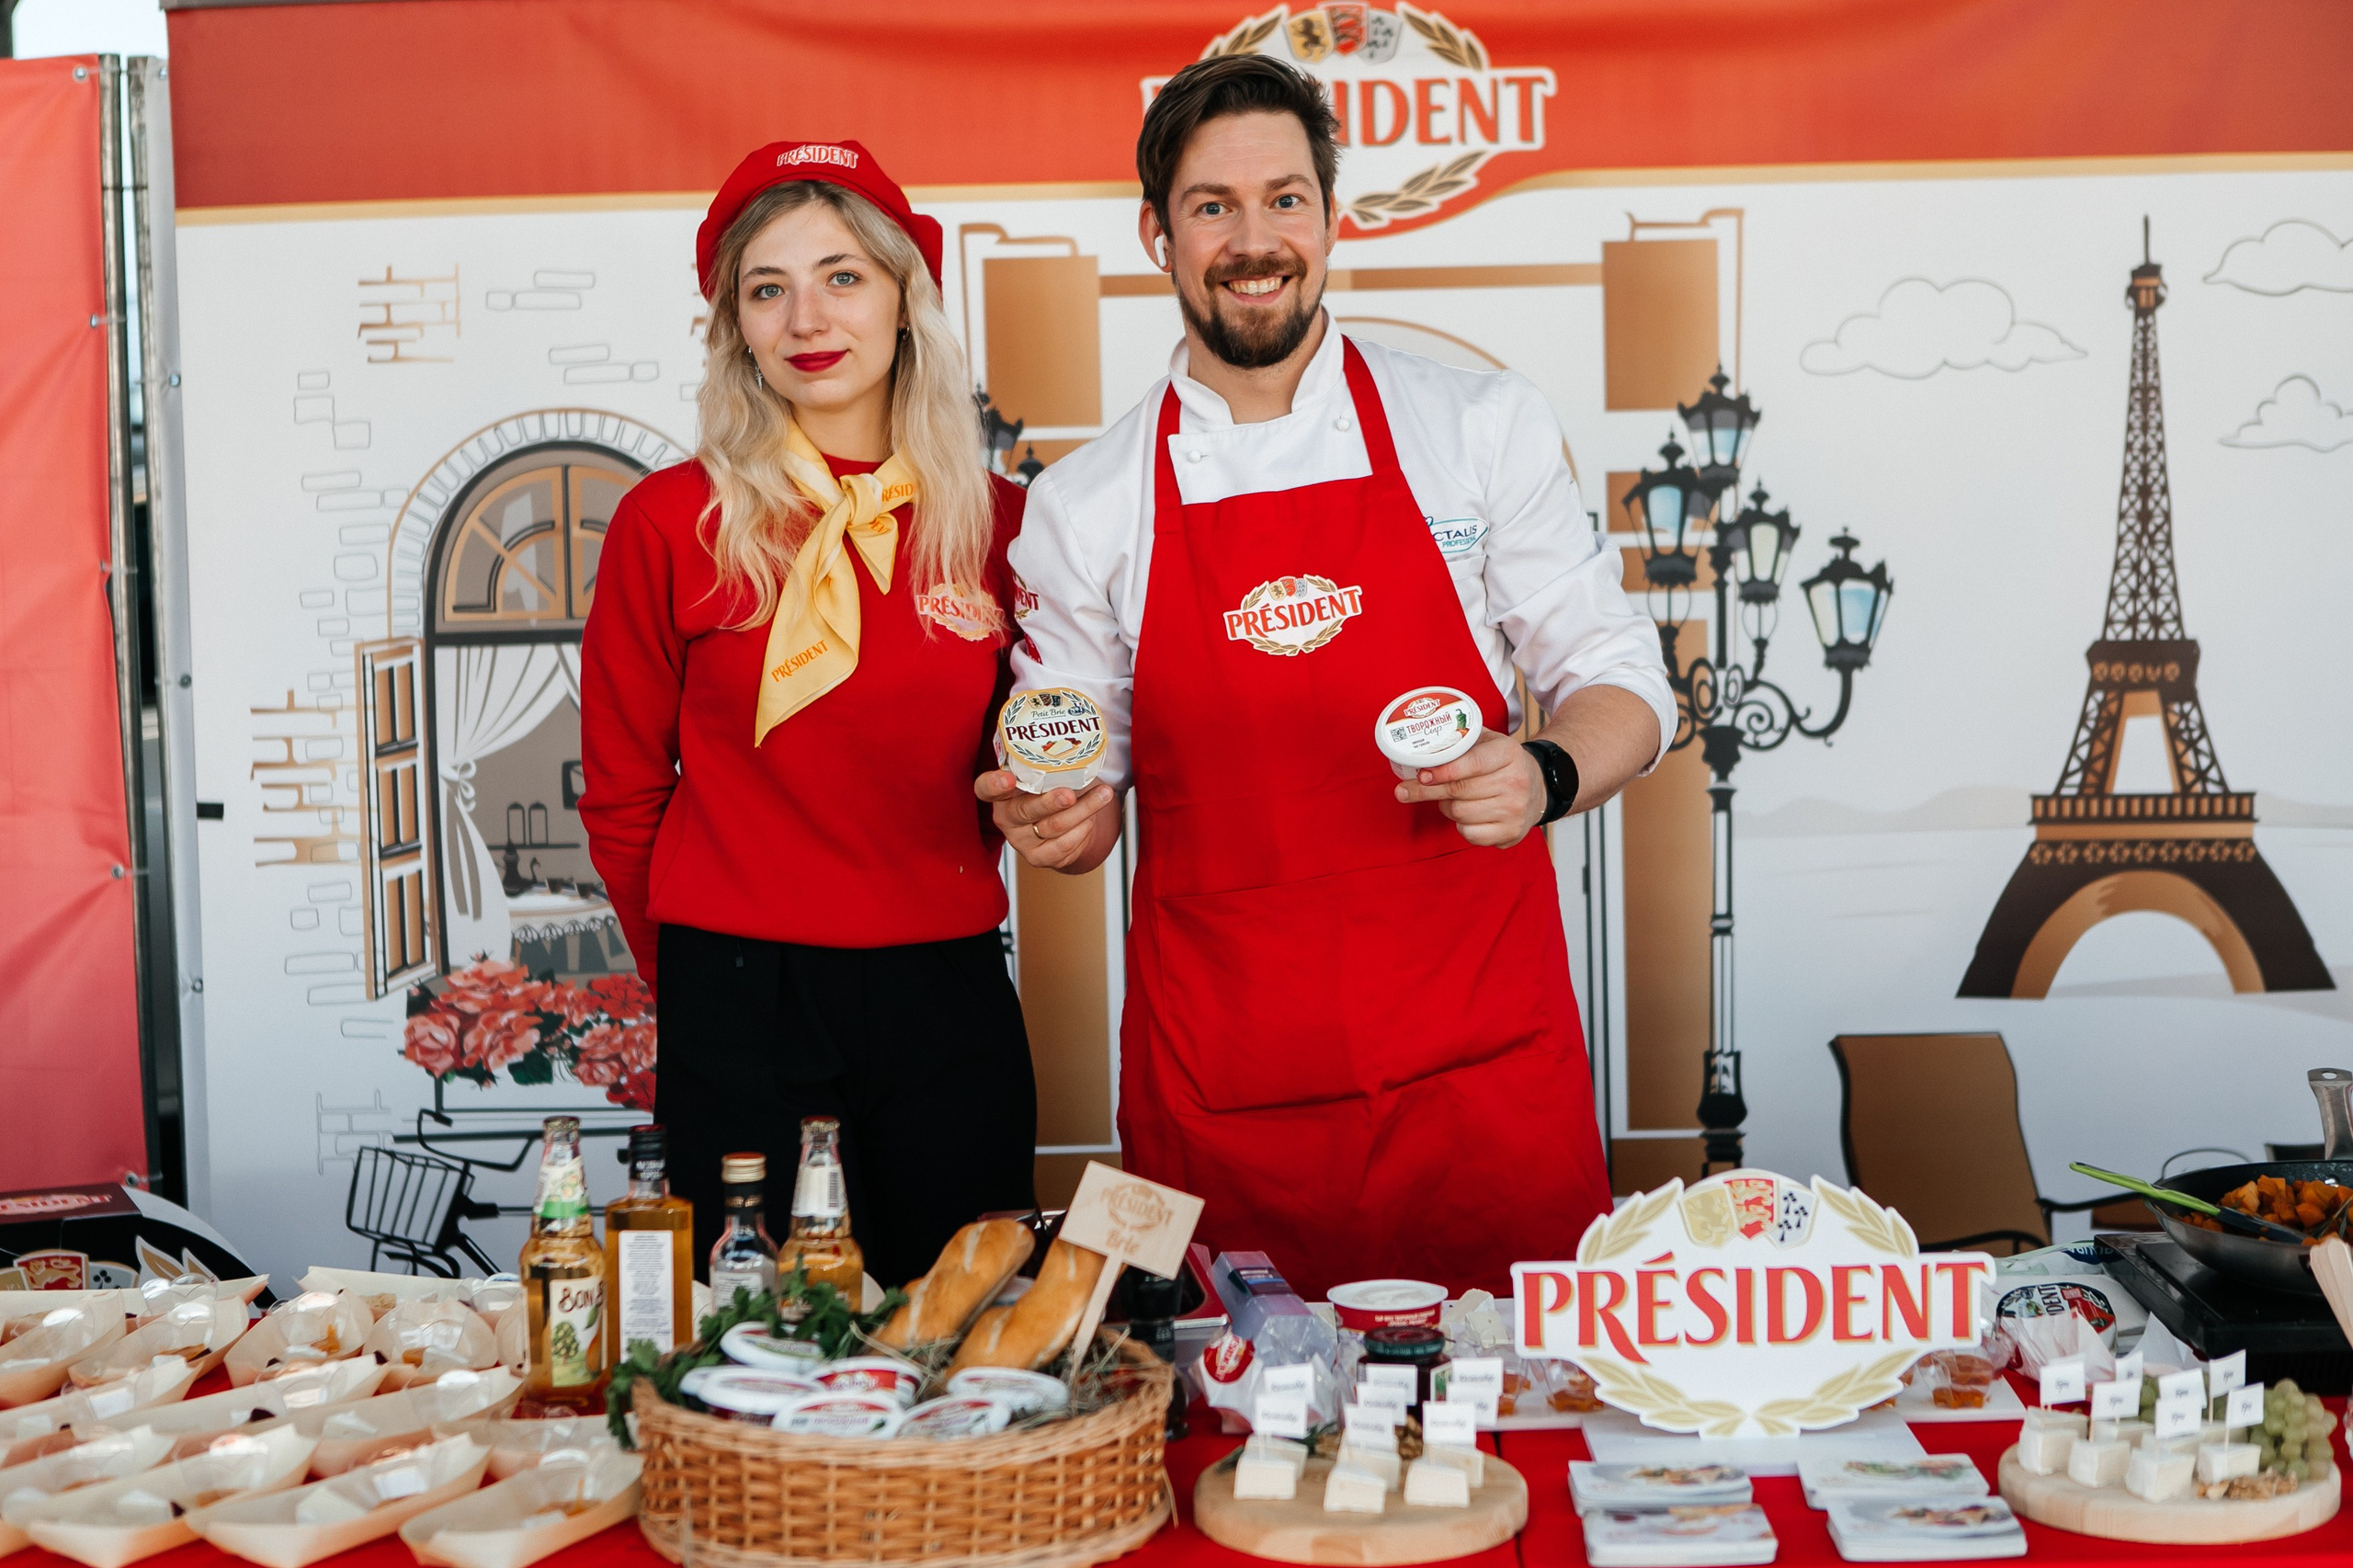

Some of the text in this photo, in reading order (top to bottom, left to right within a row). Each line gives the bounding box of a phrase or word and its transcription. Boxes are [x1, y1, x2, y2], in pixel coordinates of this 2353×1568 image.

[1334, 75, 1547, 147] IDENT
[777, 144, 858, 168] PRÉSIDENT
[1226, 589, 1360, 638] PRÉSIDENT
[771, 639, 828, 683] PRÉSIDENT
[1030, 710, 1049, 718] Petit
[1049, 708, 1066, 716] Brie
[1404, 699, 1440, 716] PRÉSIDENT
[1006, 717, 1100, 742] PRÉSIDENT
[1406, 711, 1452, 734] ТВОРОЖНЫЙ
[1521, 1250, 1986, 1364] PRÉSIDENT
